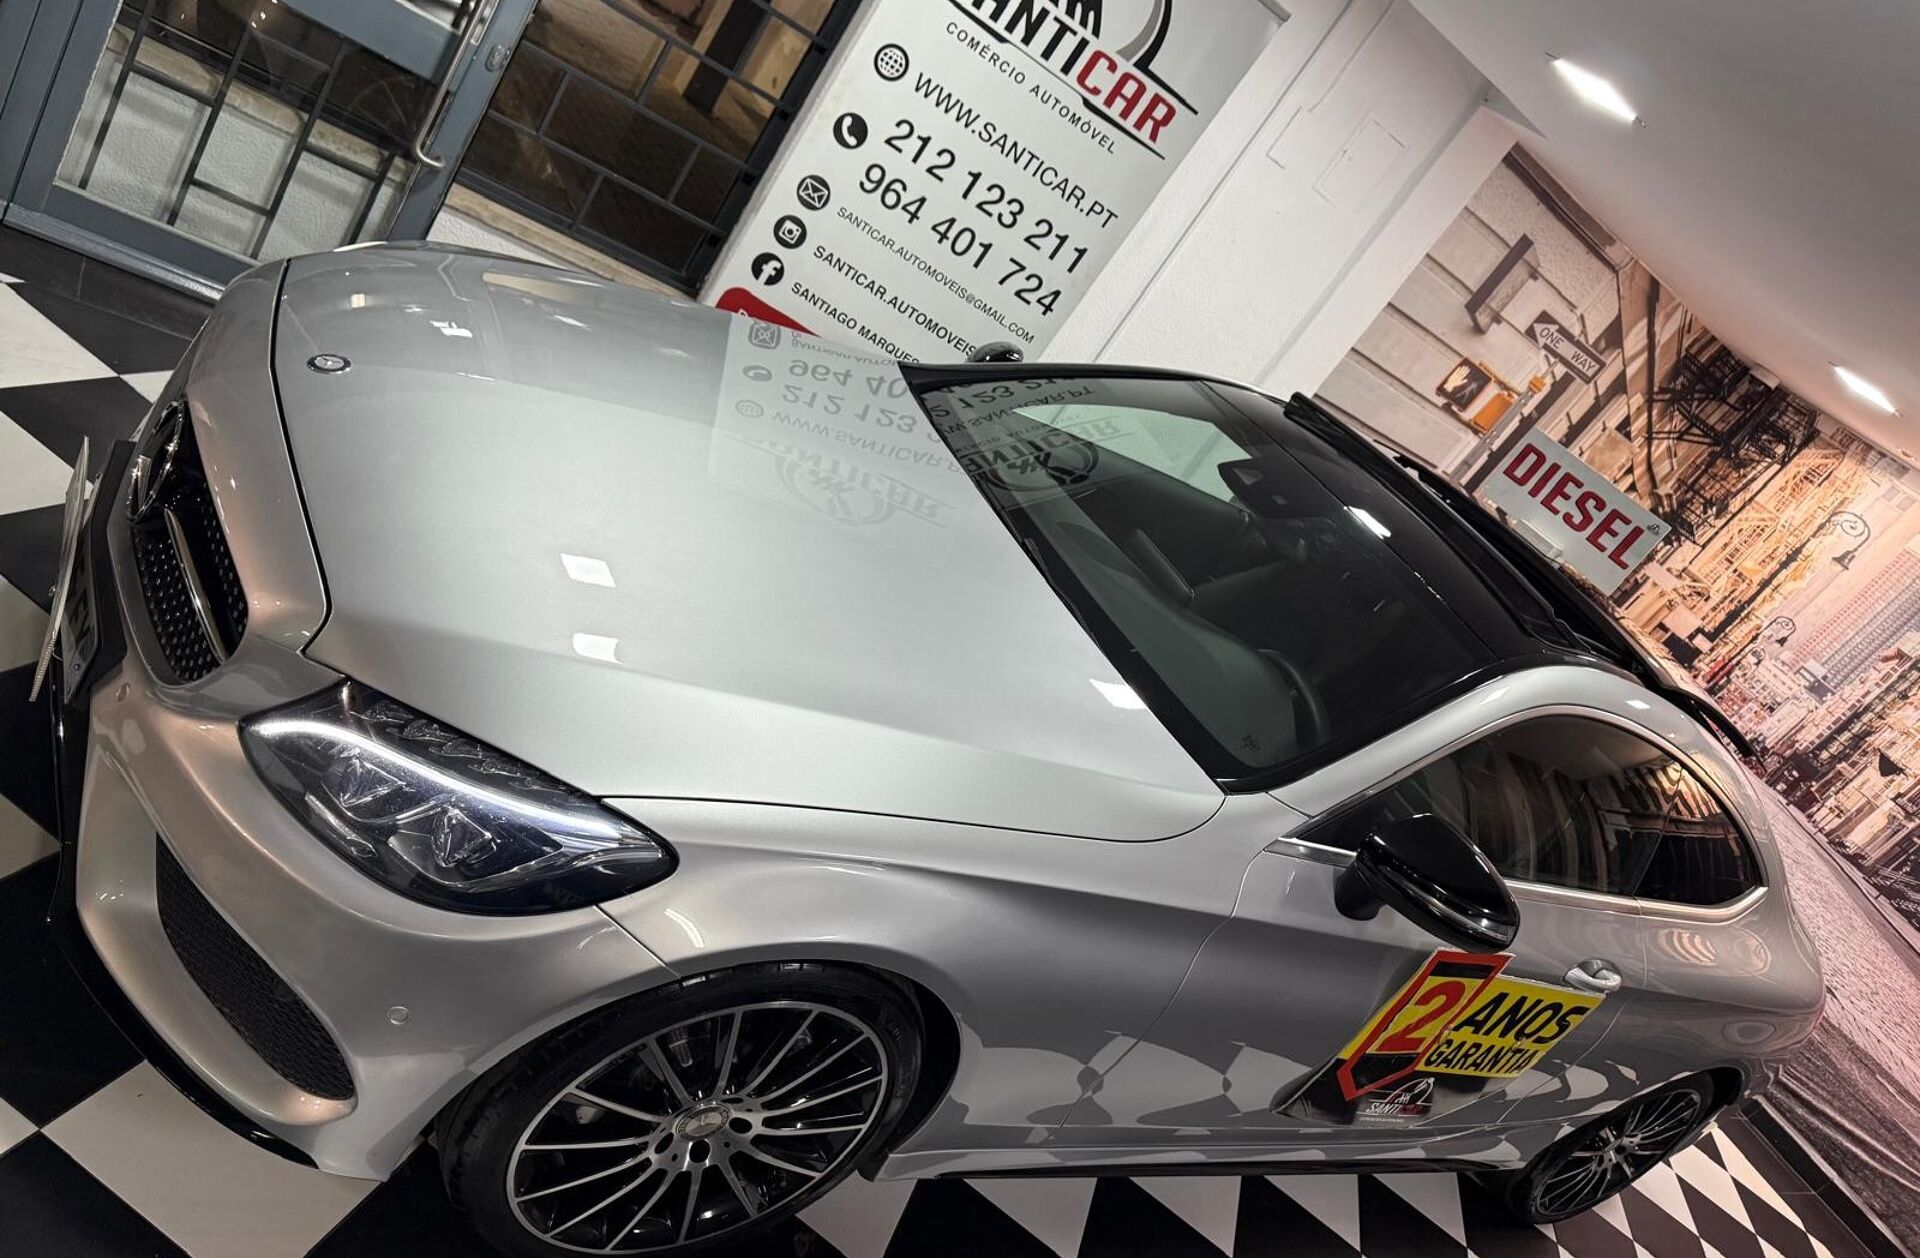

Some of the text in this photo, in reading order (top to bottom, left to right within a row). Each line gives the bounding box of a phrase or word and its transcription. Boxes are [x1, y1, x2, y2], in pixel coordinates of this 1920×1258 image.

[946, 21, 1116, 154] COMÉRCIO AUTOMÓVEL
[971, 0, 1177, 143] NTICAR
[884, 118, 1089, 275] 212 123 211
[914, 71, 1119, 229] WWW.SANTICAR.PT
[813, 245, 977, 357] SANTICAR.AUTOMOVEIS
[836, 206, 1036, 344] SANTICAR.AUTOMOVEIS@GMAIL.COM
[859, 162, 1062, 317] 964 401 724
[791, 282, 858, 330] SANTIAGO
[1538, 326, 1597, 374] ONE WAY
[1503, 443, 1646, 570] DIESEL
[1375, 979, 1467, 1053] 2
[1424, 1037, 1541, 1074] GARANTIA
[1452, 991, 1590, 1045] ANOS
